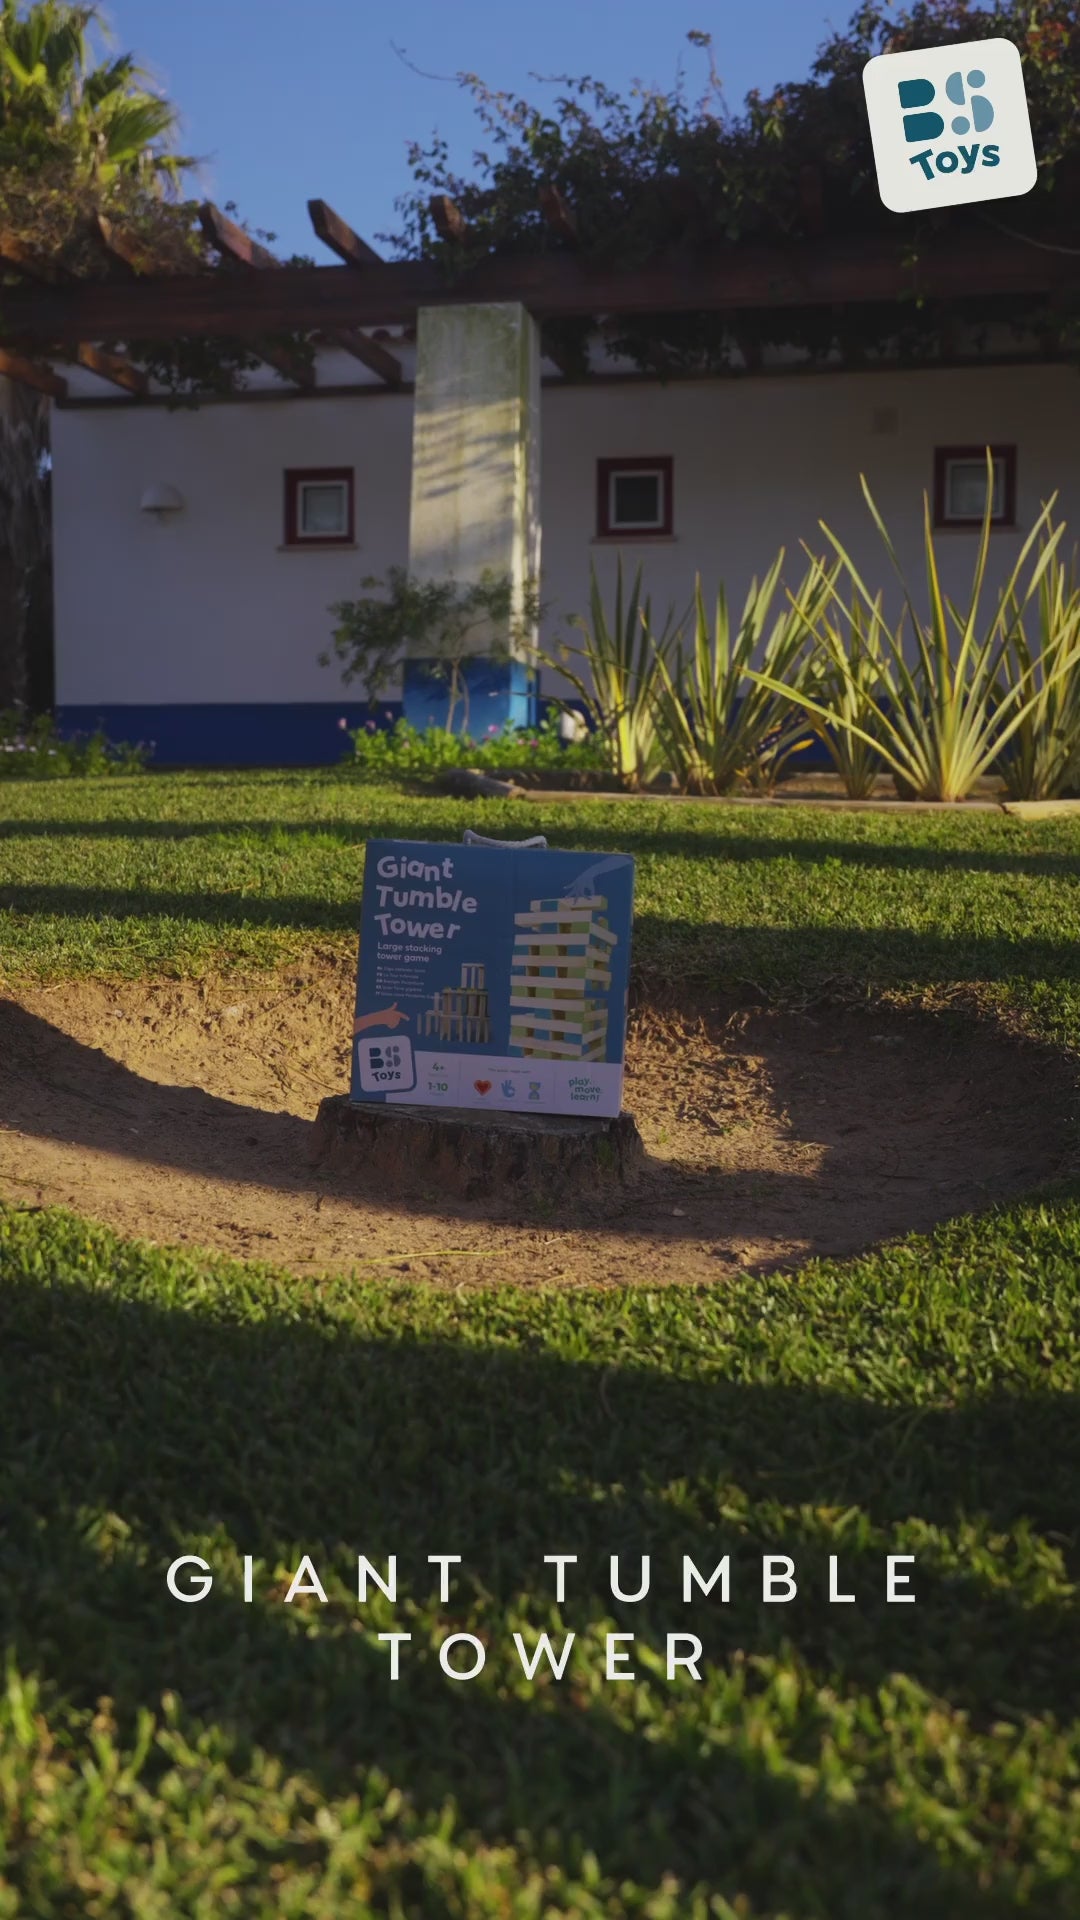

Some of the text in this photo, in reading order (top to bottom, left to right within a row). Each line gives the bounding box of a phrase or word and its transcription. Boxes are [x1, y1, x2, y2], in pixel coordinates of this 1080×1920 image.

[376, 855, 454, 882] Giant
[375, 884, 478, 913] Tumble
[373, 912, 461, 939] Tower
[376, 952, 430, 963] tower game
[377, 941, 442, 955] Large stacking
[369, 1045, 402, 1069] BS
[371, 1070, 402, 1082] Toys
[427, 1081, 449, 1092] 1-10
